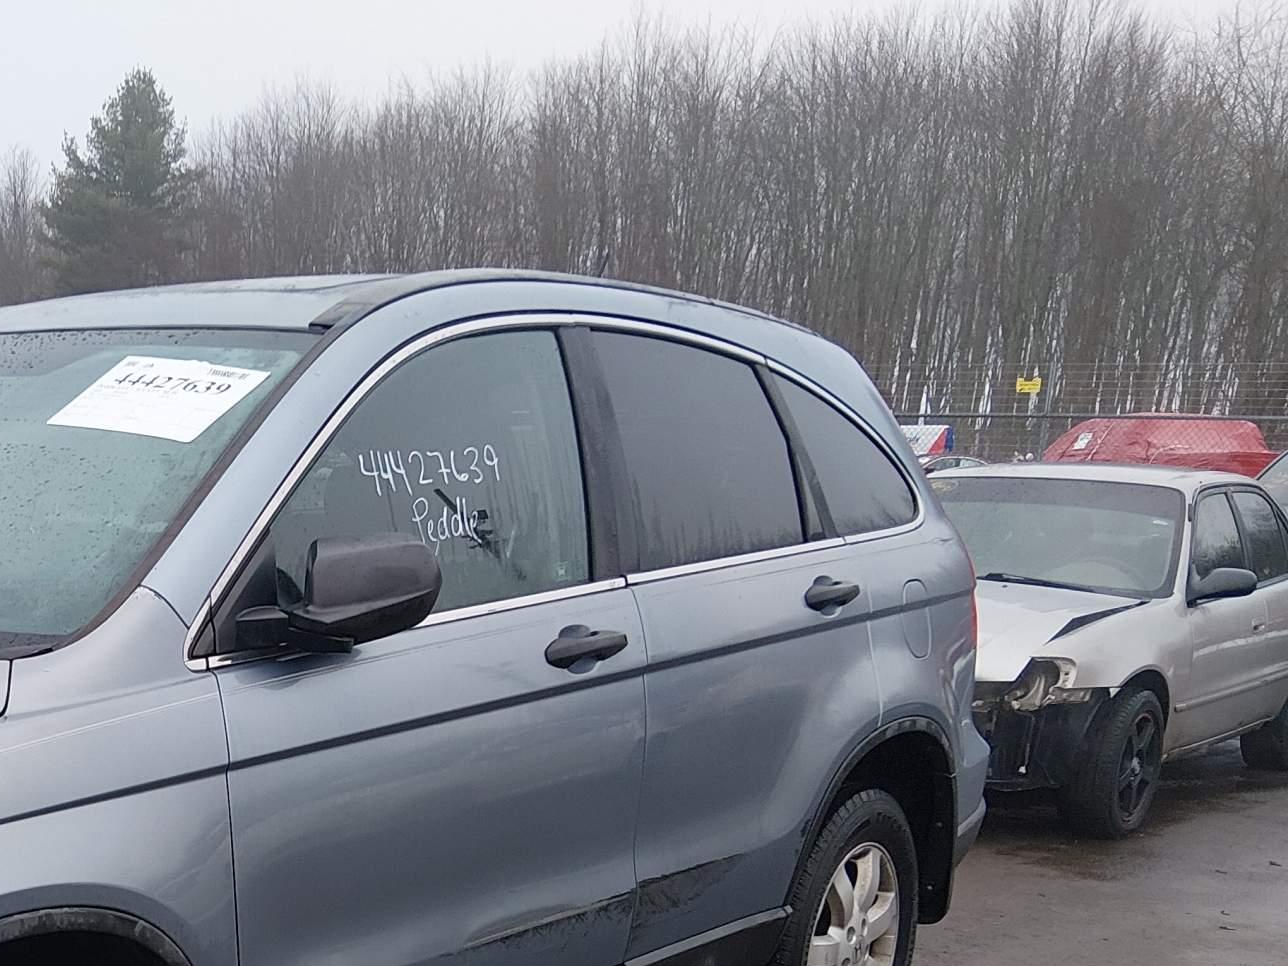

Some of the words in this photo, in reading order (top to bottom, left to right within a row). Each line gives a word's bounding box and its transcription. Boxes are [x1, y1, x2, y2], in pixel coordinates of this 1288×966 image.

[114, 372, 232, 395] 44427639
[358, 444, 501, 497] 44427639
[412, 497, 483, 546] Peddle
